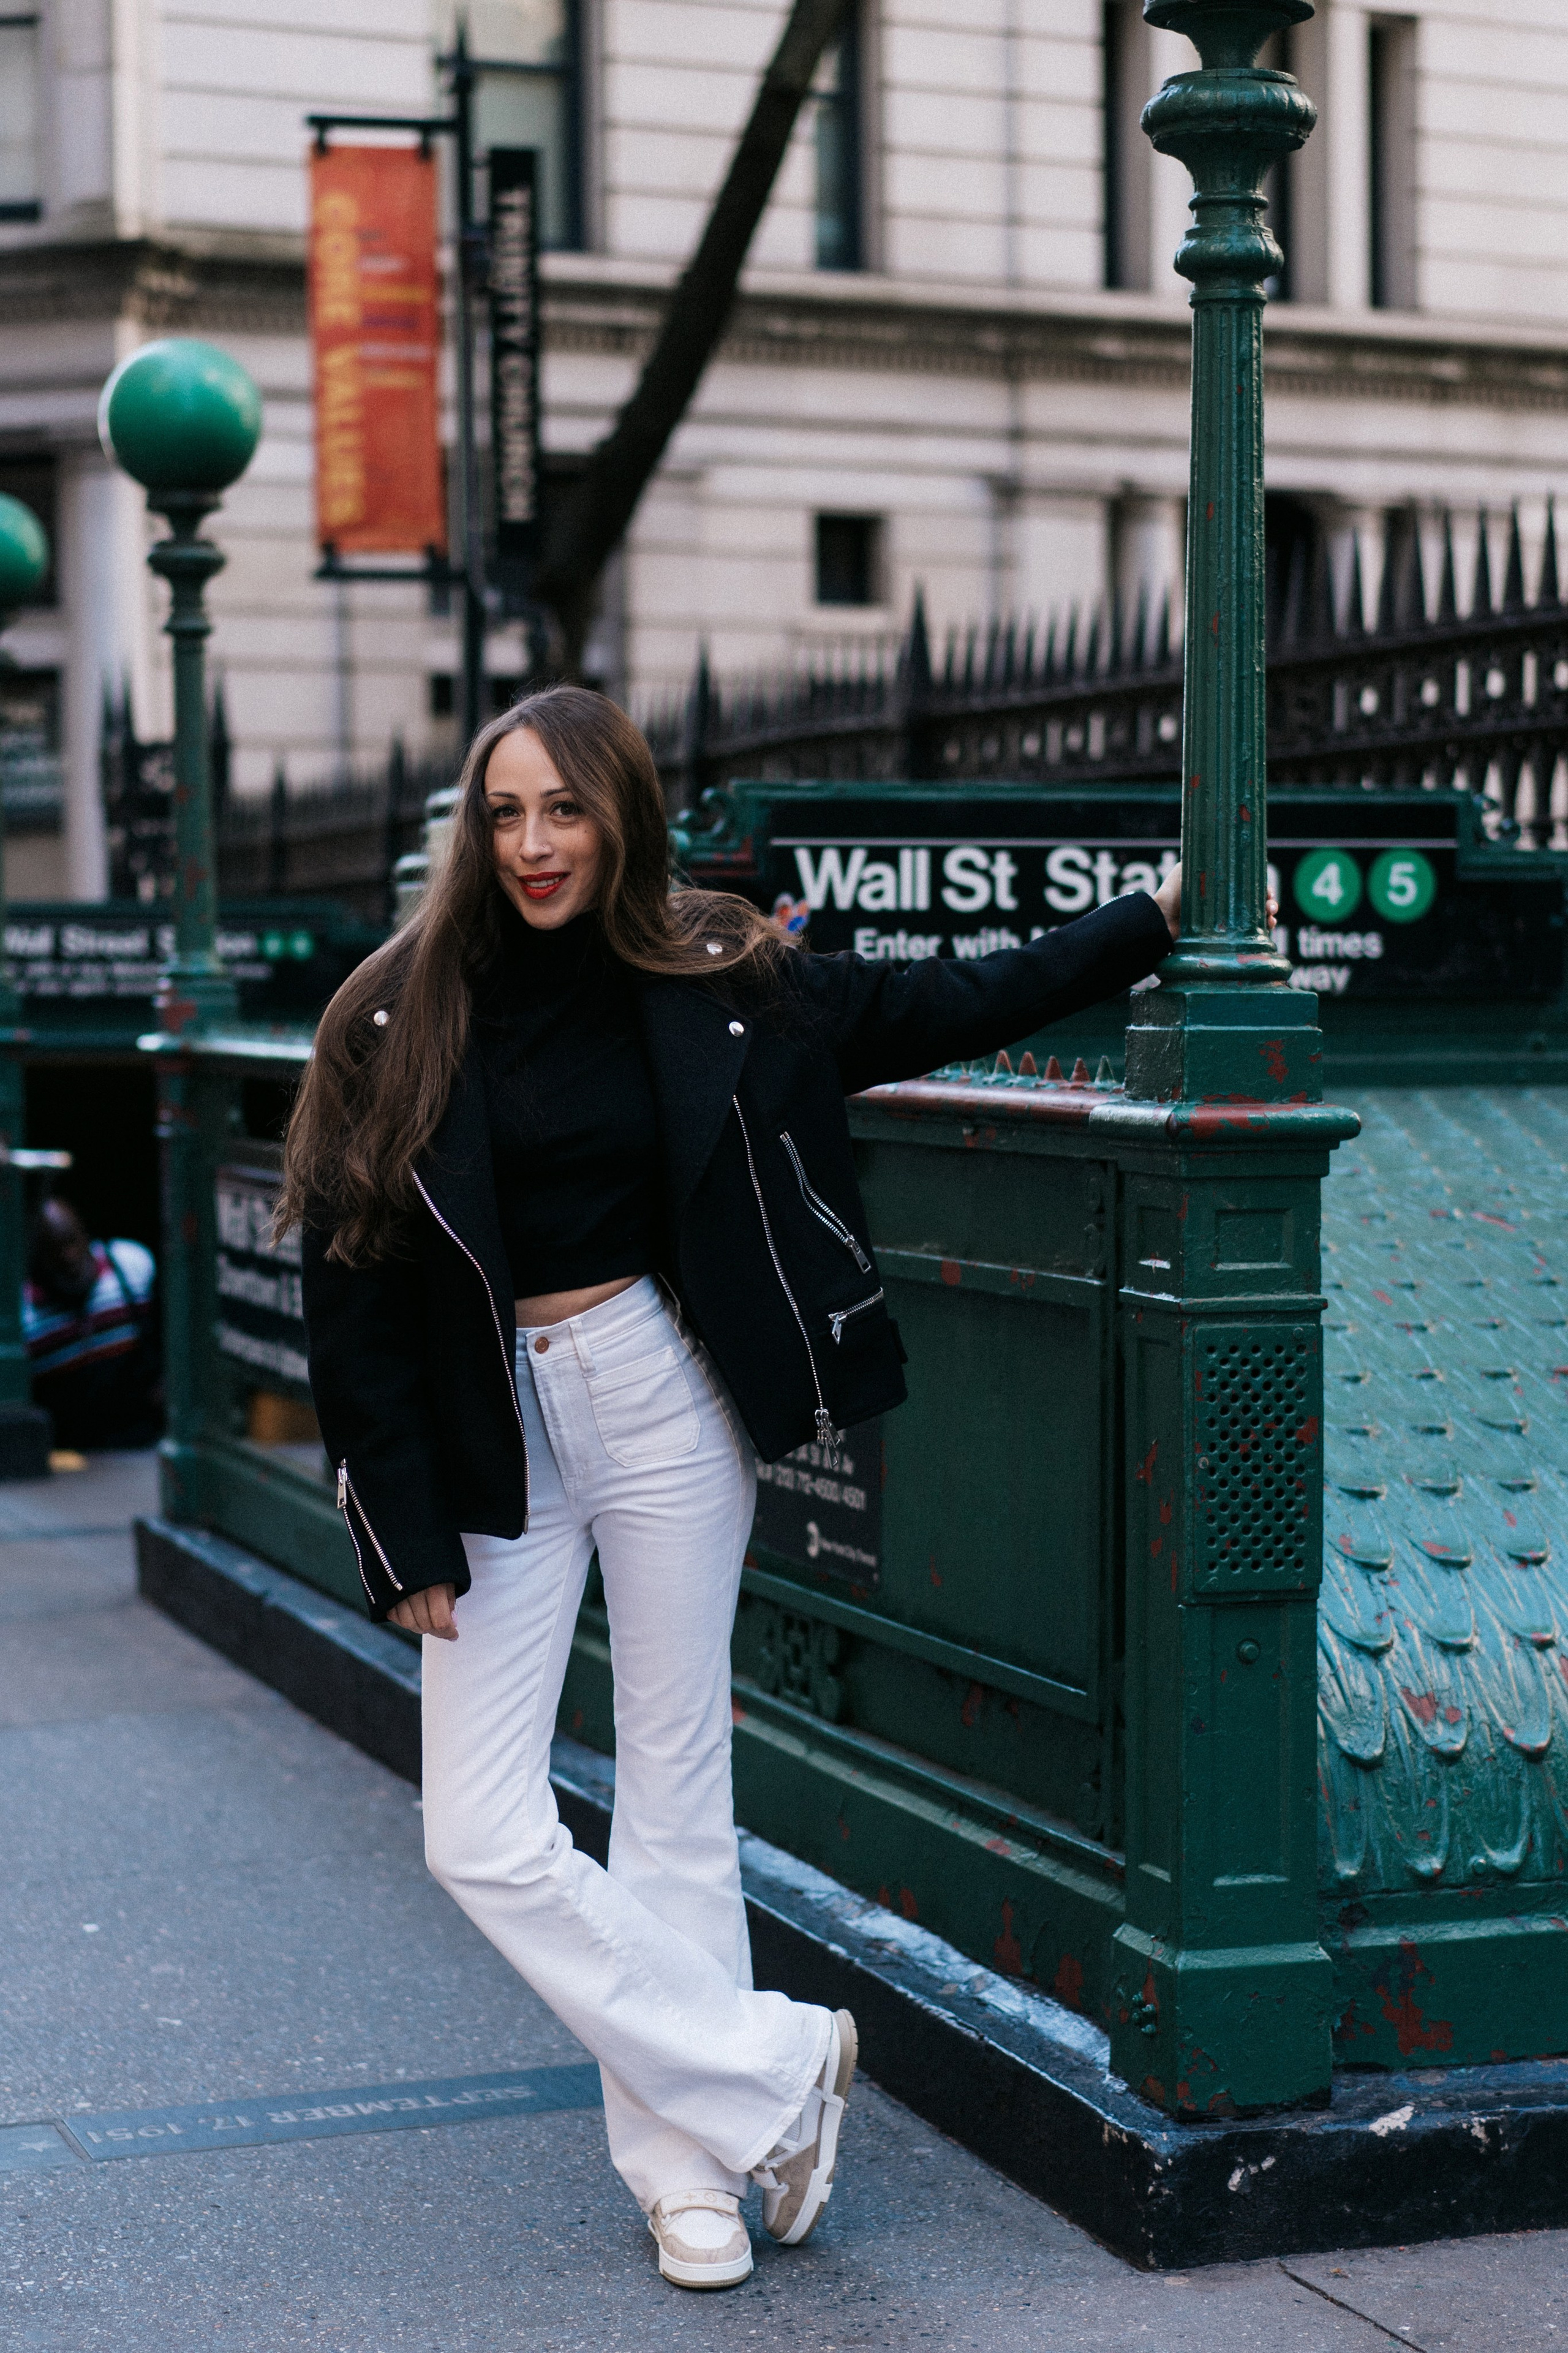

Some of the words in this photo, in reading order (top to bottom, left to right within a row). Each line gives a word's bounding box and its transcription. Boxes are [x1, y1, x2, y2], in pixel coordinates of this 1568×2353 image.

[795, 846, 932, 912] Wall
[941, 845, 1017, 913] St
[1312, 863, 1344, 906] 4
[1387, 862, 1417, 907] 5
[854, 926, 943, 961] Enter
[952, 926, 1022, 960] with
[1298, 926, 1383, 959] times
[266, 2085, 537, 2124] SEPTEMBER
[86, 2121, 185, 2144] 1951
